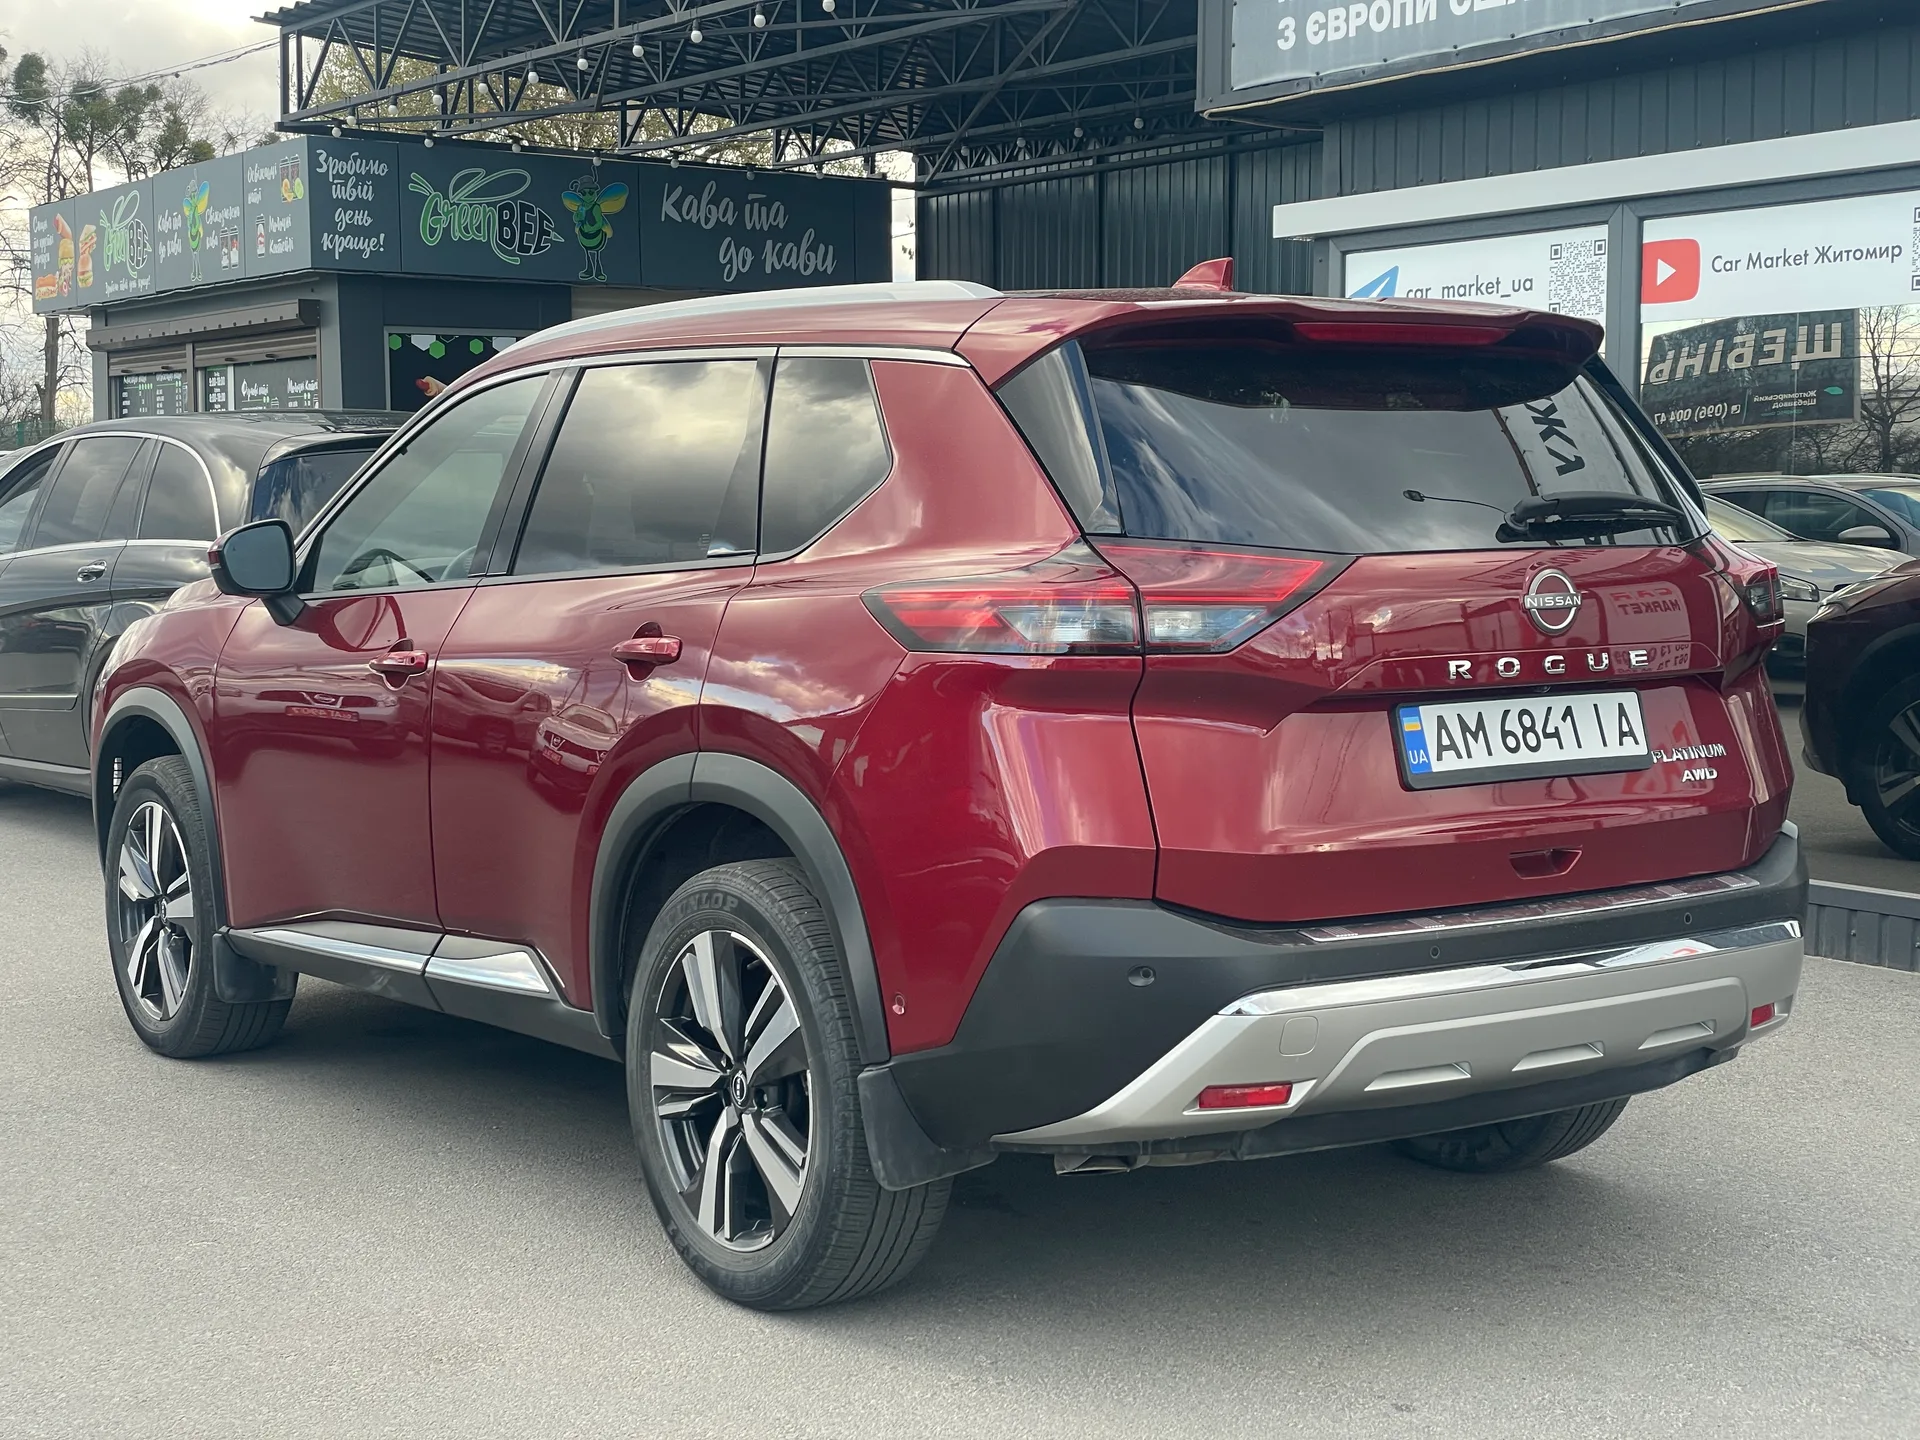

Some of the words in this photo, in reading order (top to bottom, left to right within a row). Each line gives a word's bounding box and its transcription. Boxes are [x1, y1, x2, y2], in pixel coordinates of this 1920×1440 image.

[1277, 16, 1296, 50] З
[316, 149, 389, 182] Зробимо
[331, 176, 374, 201] твій
[334, 207, 374, 232] день
[661, 179, 739, 230] Кава
[745, 193, 789, 232] та
[320, 233, 386, 260] краще!
[718, 236, 755, 282] до
[762, 227, 838, 277] кави
[1711, 254, 1742, 274] Car
[1746, 247, 1809, 271] Market
[1813, 243, 1903, 264] Житомир
[1406, 274, 1533, 300] carmarket_ua
[1525, 595, 1582, 608] NISSAN
[1448, 649, 1649, 680] ROGUE
[1409, 749, 1429, 765] UA
[1436, 711, 1494, 762] AM
[1500, 705, 1583, 754] 6841
[1592, 702, 1641, 748] IA
[1650, 742, 1727, 764] PLATINUM
[1681, 767, 1719, 783] AWD
